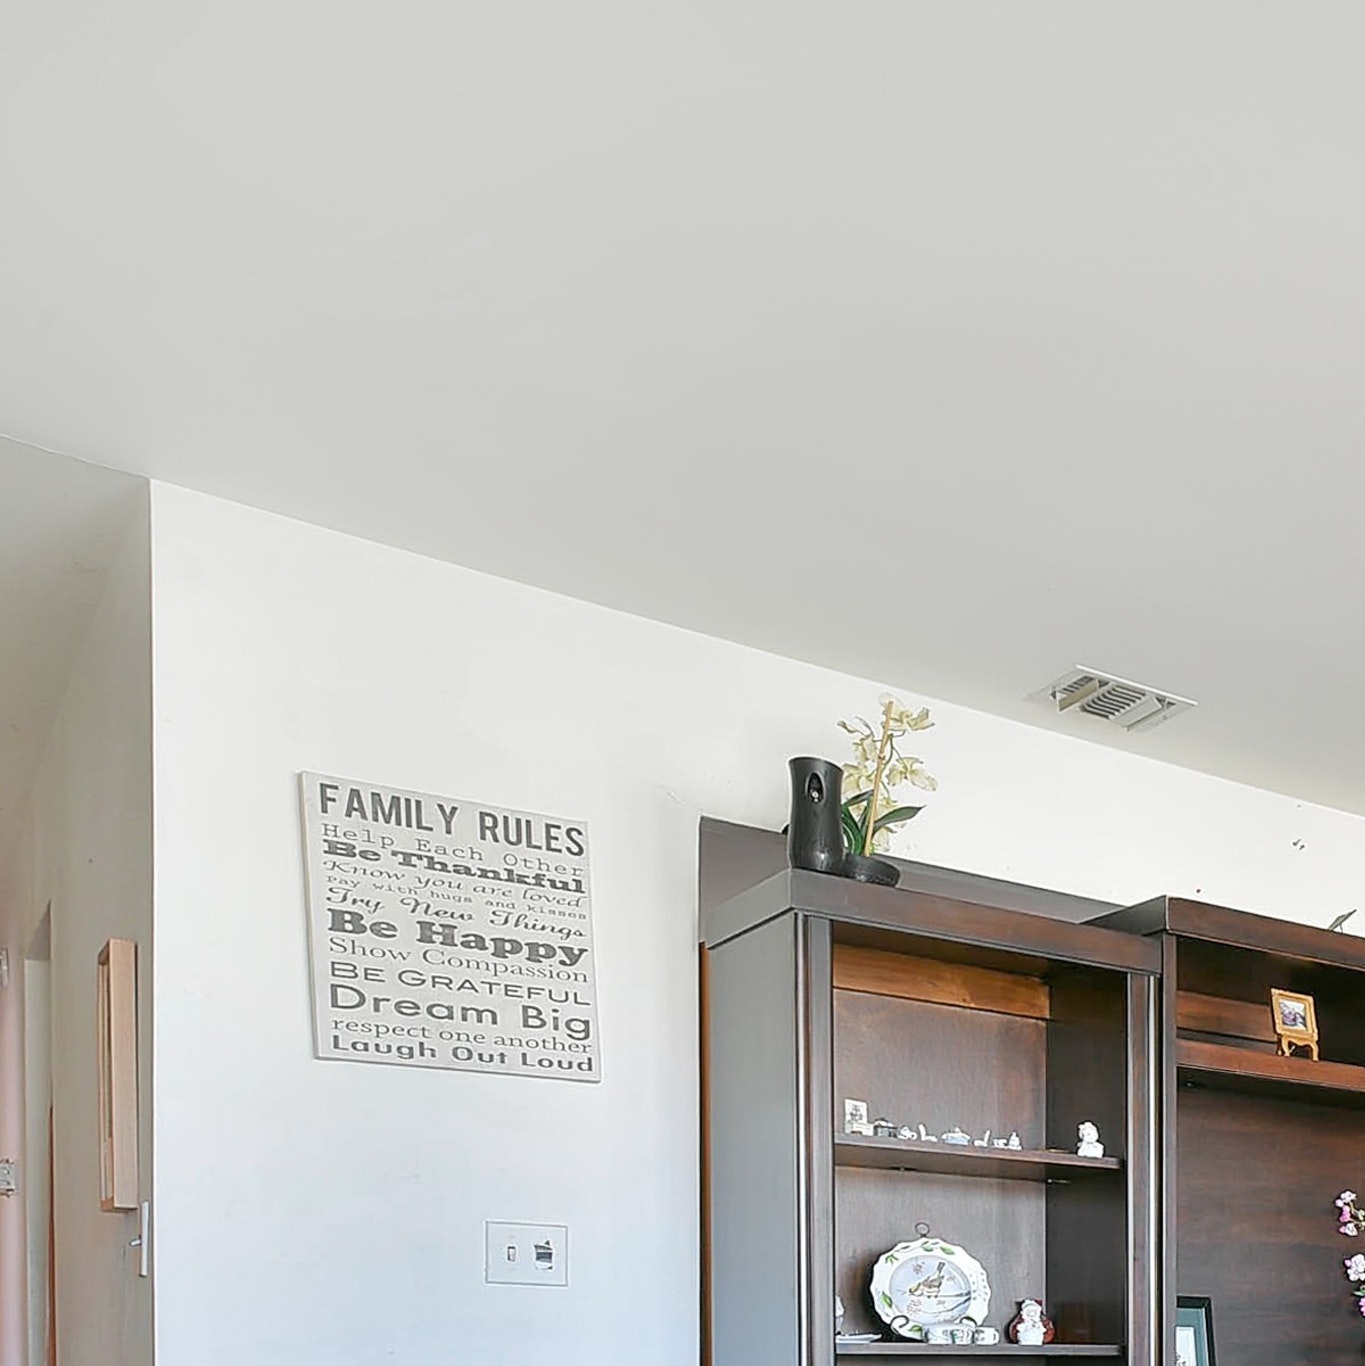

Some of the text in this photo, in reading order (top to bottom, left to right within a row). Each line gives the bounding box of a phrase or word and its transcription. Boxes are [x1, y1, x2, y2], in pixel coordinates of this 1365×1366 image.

[319, 782, 585, 857] FAMILY RULES
[322, 823, 584, 876] Help Each Other
[323, 839, 586, 893] Be Thankful
[323, 861, 584, 908] Know you are loved
[373, 882, 418, 896] with
[430, 891, 473, 904] hugs
[485, 897, 516, 909] and
[326, 887, 586, 940] Try New Things
[327, 908, 588, 967] Be Happy
[330, 937, 588, 983] Show Compassion
[330, 961, 591, 1006] BE GRATEFUL
[330, 984, 591, 1041] Dream Big
[331, 1017, 592, 1054] respect one another
[332, 1035, 593, 1072] Laugh Out Loud
